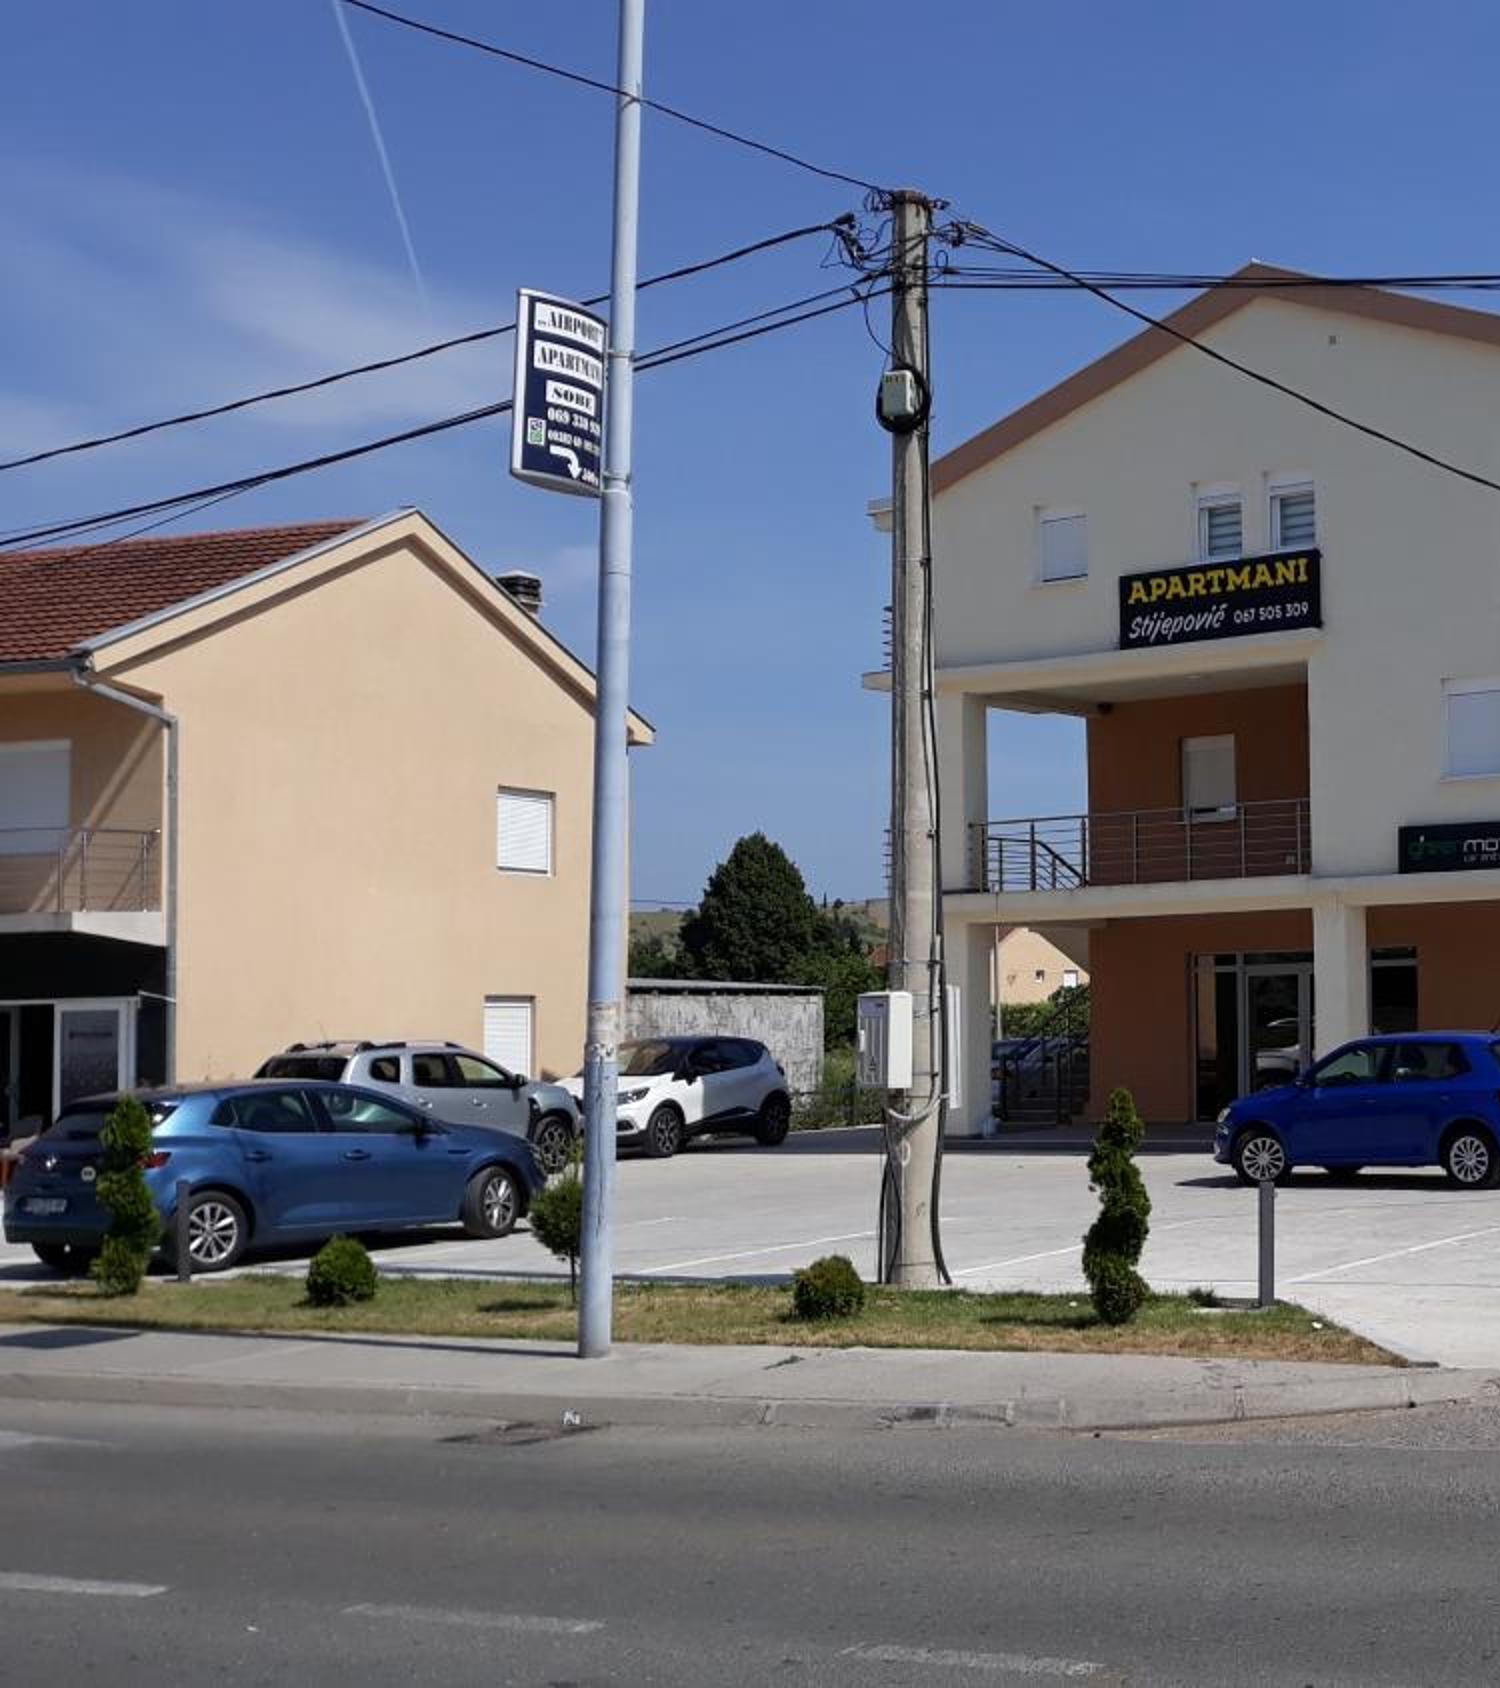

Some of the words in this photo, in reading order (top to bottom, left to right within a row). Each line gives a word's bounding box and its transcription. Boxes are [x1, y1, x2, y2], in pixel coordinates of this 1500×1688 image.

[551, 387, 593, 410] SOBE
[1128, 558, 1308, 604] APARTMANI
[1129, 603, 1229, 642] Stijepović
[1233, 608, 1255, 625] 067
[1259, 605, 1282, 621] 505
[1285, 601, 1309, 617] 309
